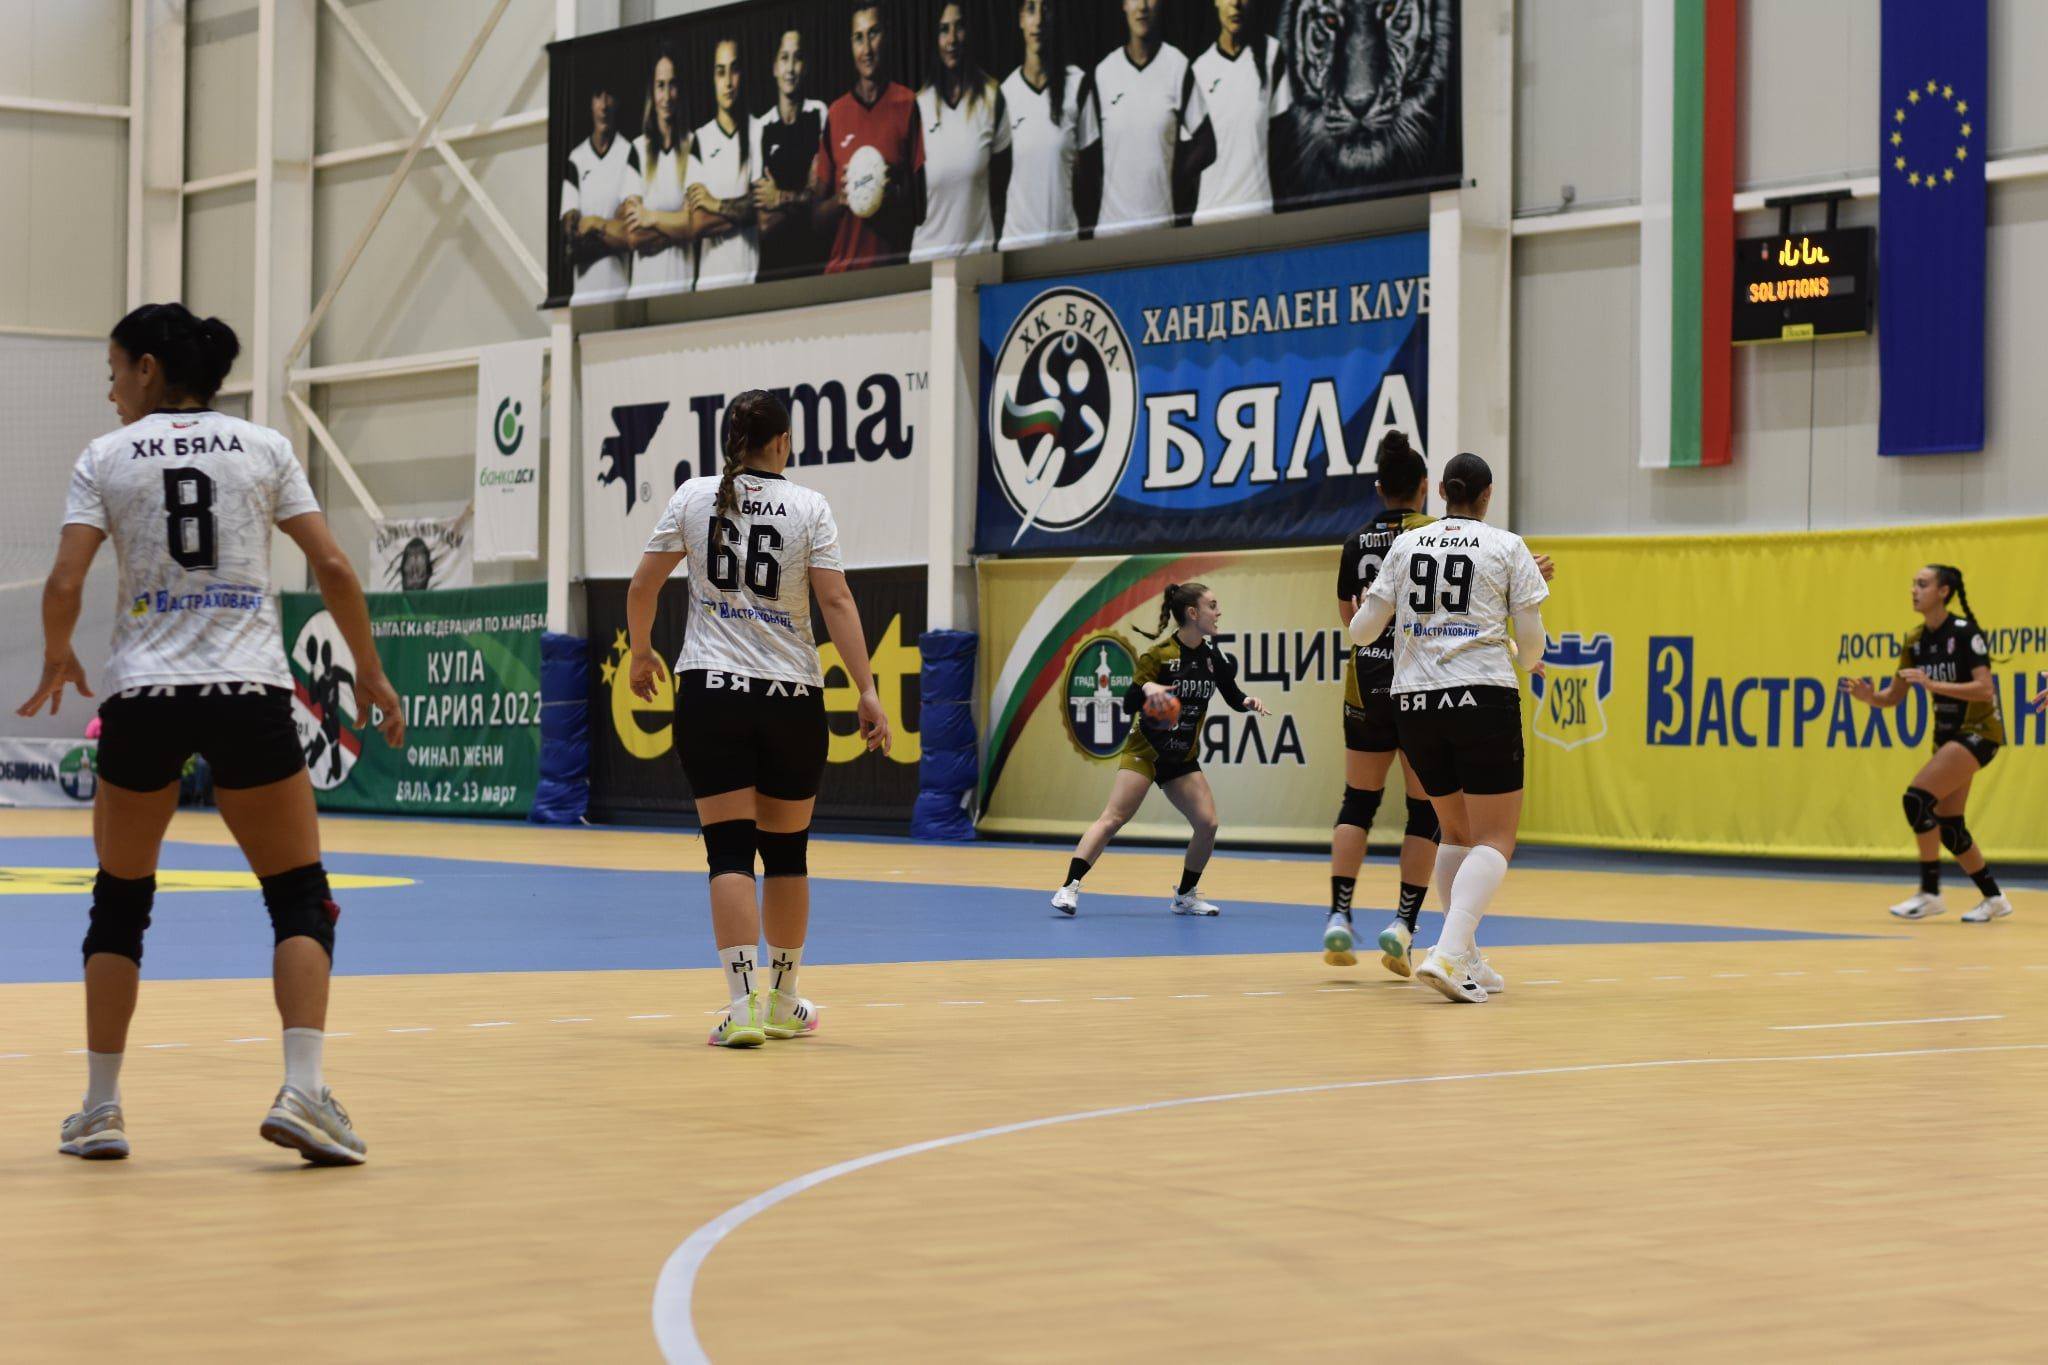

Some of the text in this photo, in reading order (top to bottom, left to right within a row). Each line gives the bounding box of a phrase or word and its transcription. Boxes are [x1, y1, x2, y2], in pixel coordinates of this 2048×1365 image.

[1749, 276, 1829, 302] SOLUTIONS
[1141, 287, 1337, 345] ХАНДБАЛЕН
[131, 435, 244, 459] ХК БЯЛА
[674, 373, 914, 492] Jma
[1144, 373, 1429, 489] БЯЛА
[163, 467, 218, 571] 8
[741, 500, 787, 516] БЯЛА
[708, 516, 784, 600] 66
[1416, 536, 1480, 548] ХК БЯЛА
[1409, 553, 1475, 615] 99
[485, 616, 499, 632] ПО
[1837, 632, 1908, 664] ДОСТЪ
[428, 650, 485, 684] КУПА
[1074, 675, 1095, 688] ГРАД
[489, 691, 541, 725] 2022
[1203, 714, 1306, 765] ЯЛА
[407, 745, 504, 768] ФИНАЛ ЖЕНИ
[435, 781, 451, 802] 12
[462, 780, 478, 802] 13
[481, 785, 517, 806] март
